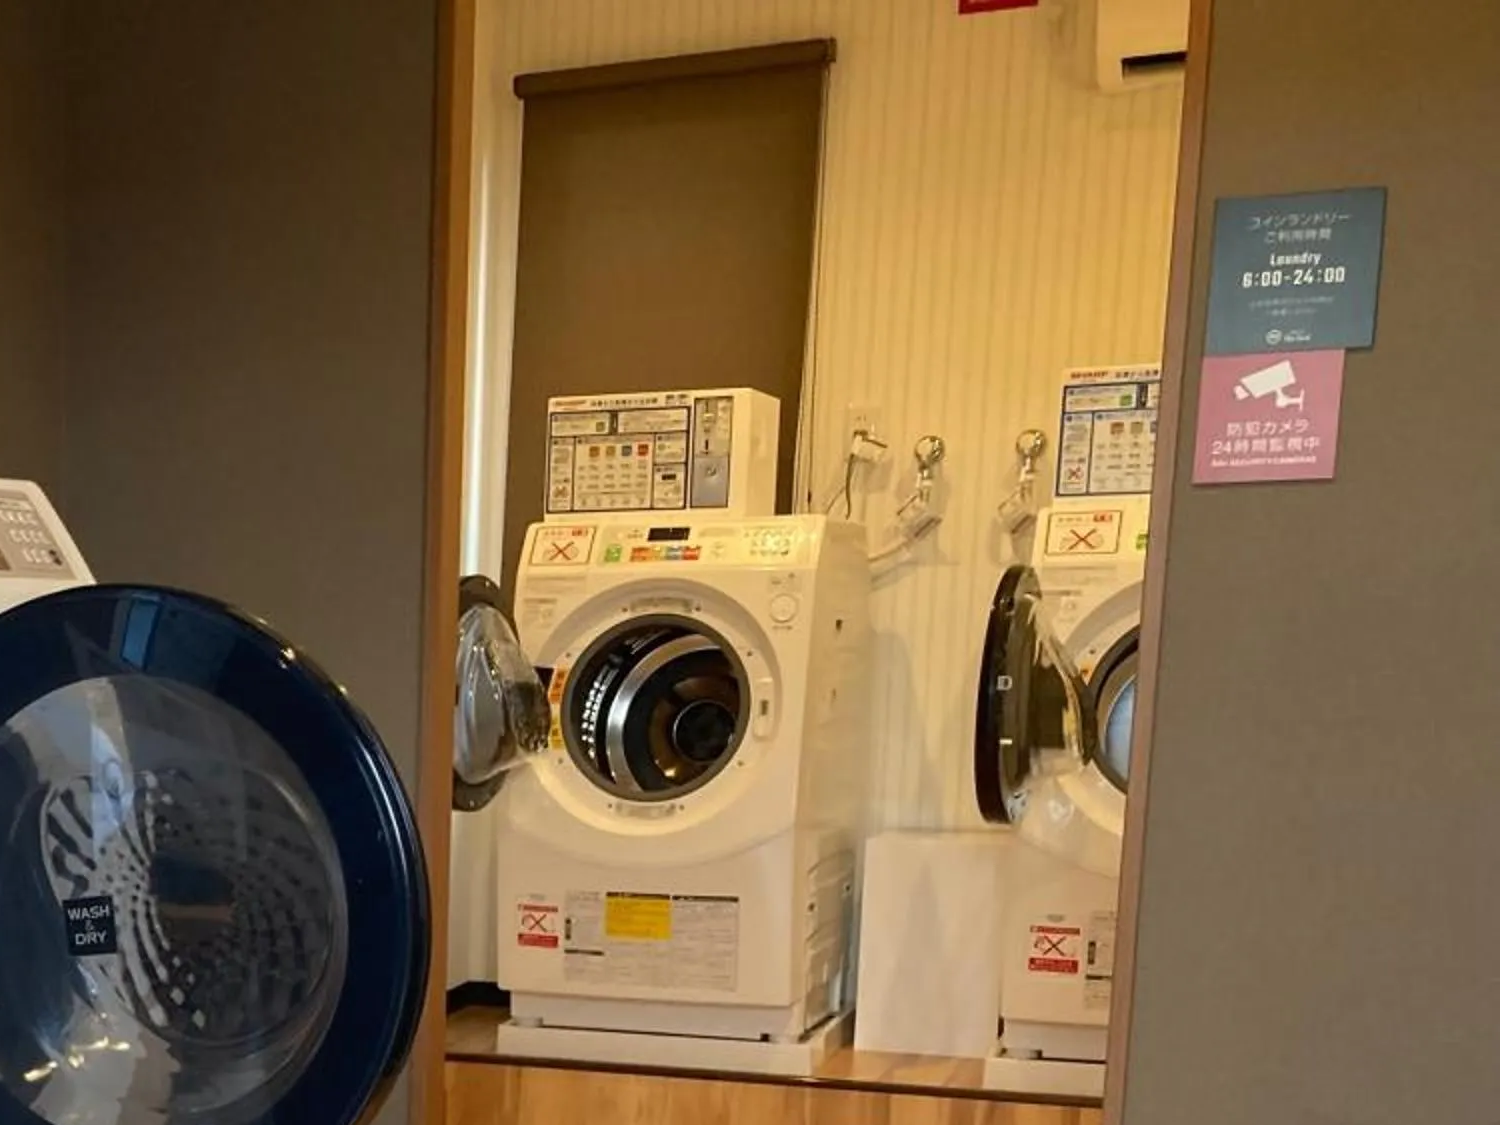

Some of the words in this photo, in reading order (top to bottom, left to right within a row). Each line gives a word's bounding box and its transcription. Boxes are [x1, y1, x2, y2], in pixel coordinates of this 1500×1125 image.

[1249, 213, 1350, 230] コインランドリー
[1270, 252, 1321, 266] Laundry
[1242, 266, 1346, 288] 6:00-24:00
[1227, 419, 1309, 436] 防犯カメラ
[67, 905, 110, 920] WASH
[76, 929, 107, 945] DRY
